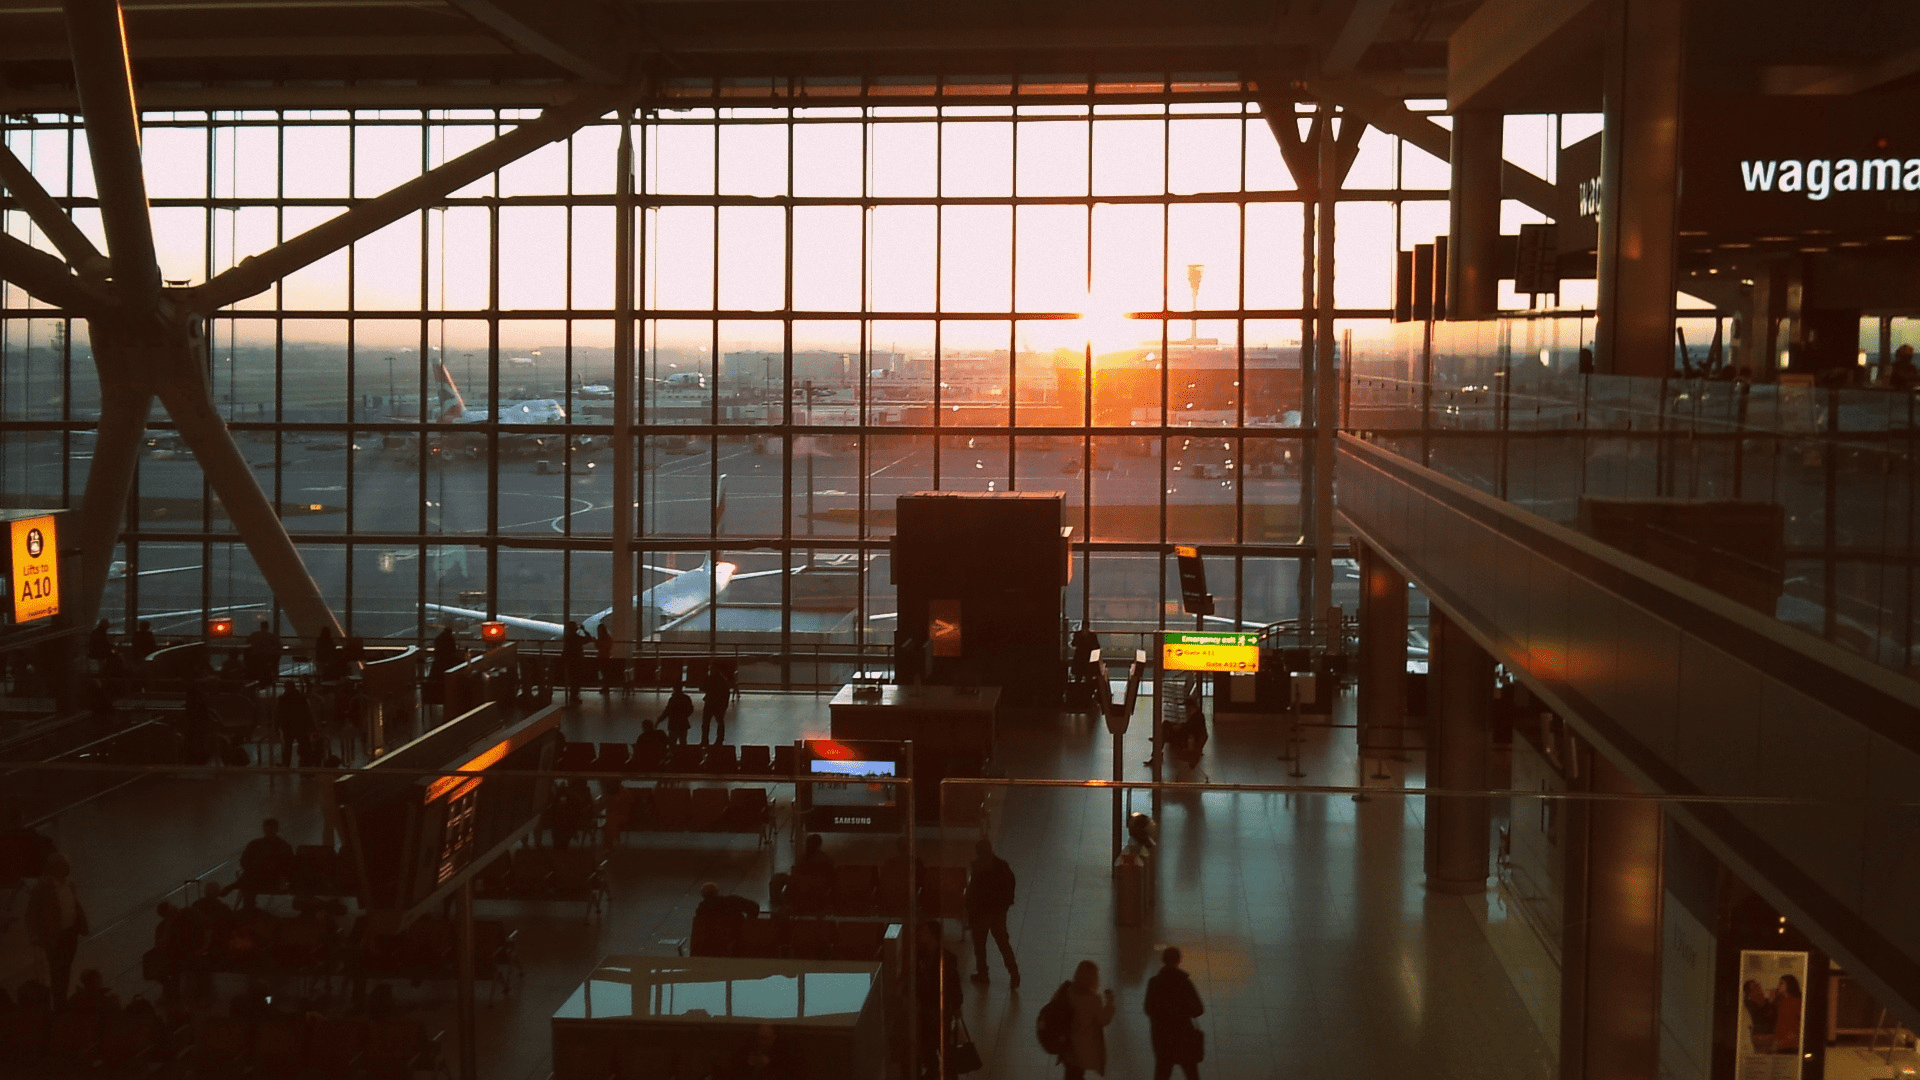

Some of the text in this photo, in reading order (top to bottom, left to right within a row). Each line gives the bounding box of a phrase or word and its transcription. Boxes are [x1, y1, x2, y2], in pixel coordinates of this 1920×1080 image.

[1741, 158, 1920, 200] wagama
[23, 563, 49, 576] Lifts to
[21, 576, 51, 601] A10
[1181, 635, 1220, 644] Emergency
[834, 817, 871, 825] SAMSUNG
